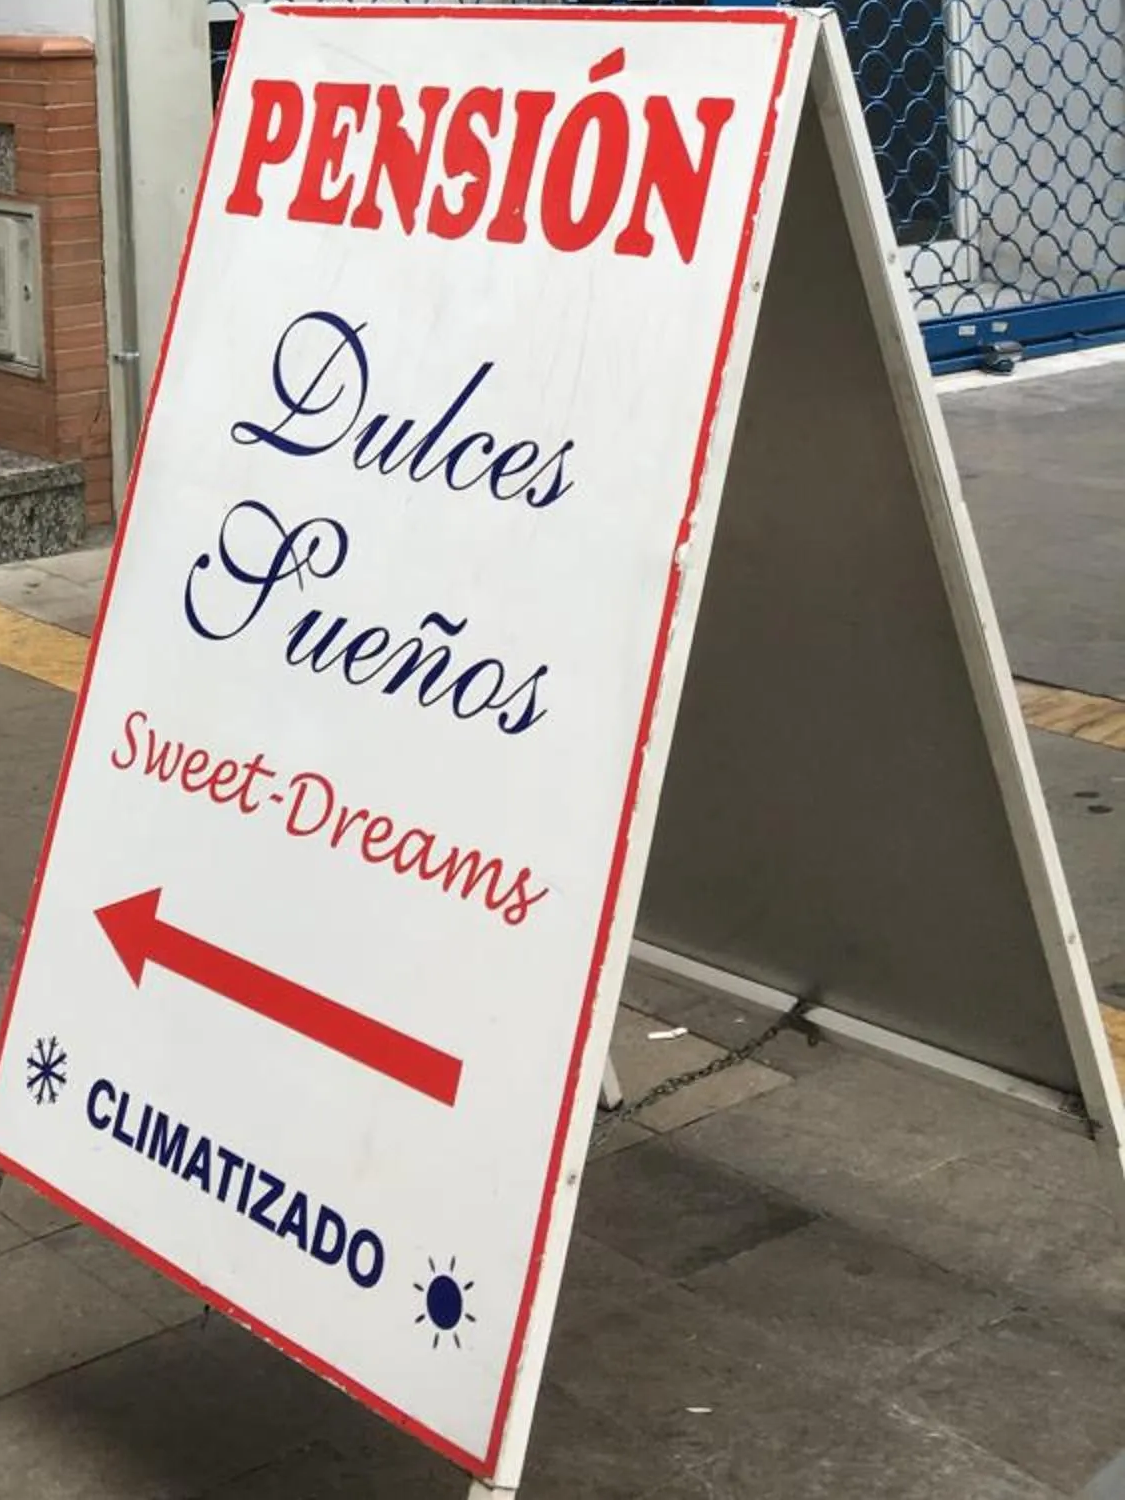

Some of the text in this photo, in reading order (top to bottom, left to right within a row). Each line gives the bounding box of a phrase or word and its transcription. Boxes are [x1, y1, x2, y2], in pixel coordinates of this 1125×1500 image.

[225, 47, 736, 264] PENSIÓN
[230, 310, 575, 508] Dulces
[183, 499, 549, 735] Sueños
[110, 711, 549, 925] Sweet-Dreams
[85, 1078, 386, 1289] CLIMATIZADO
